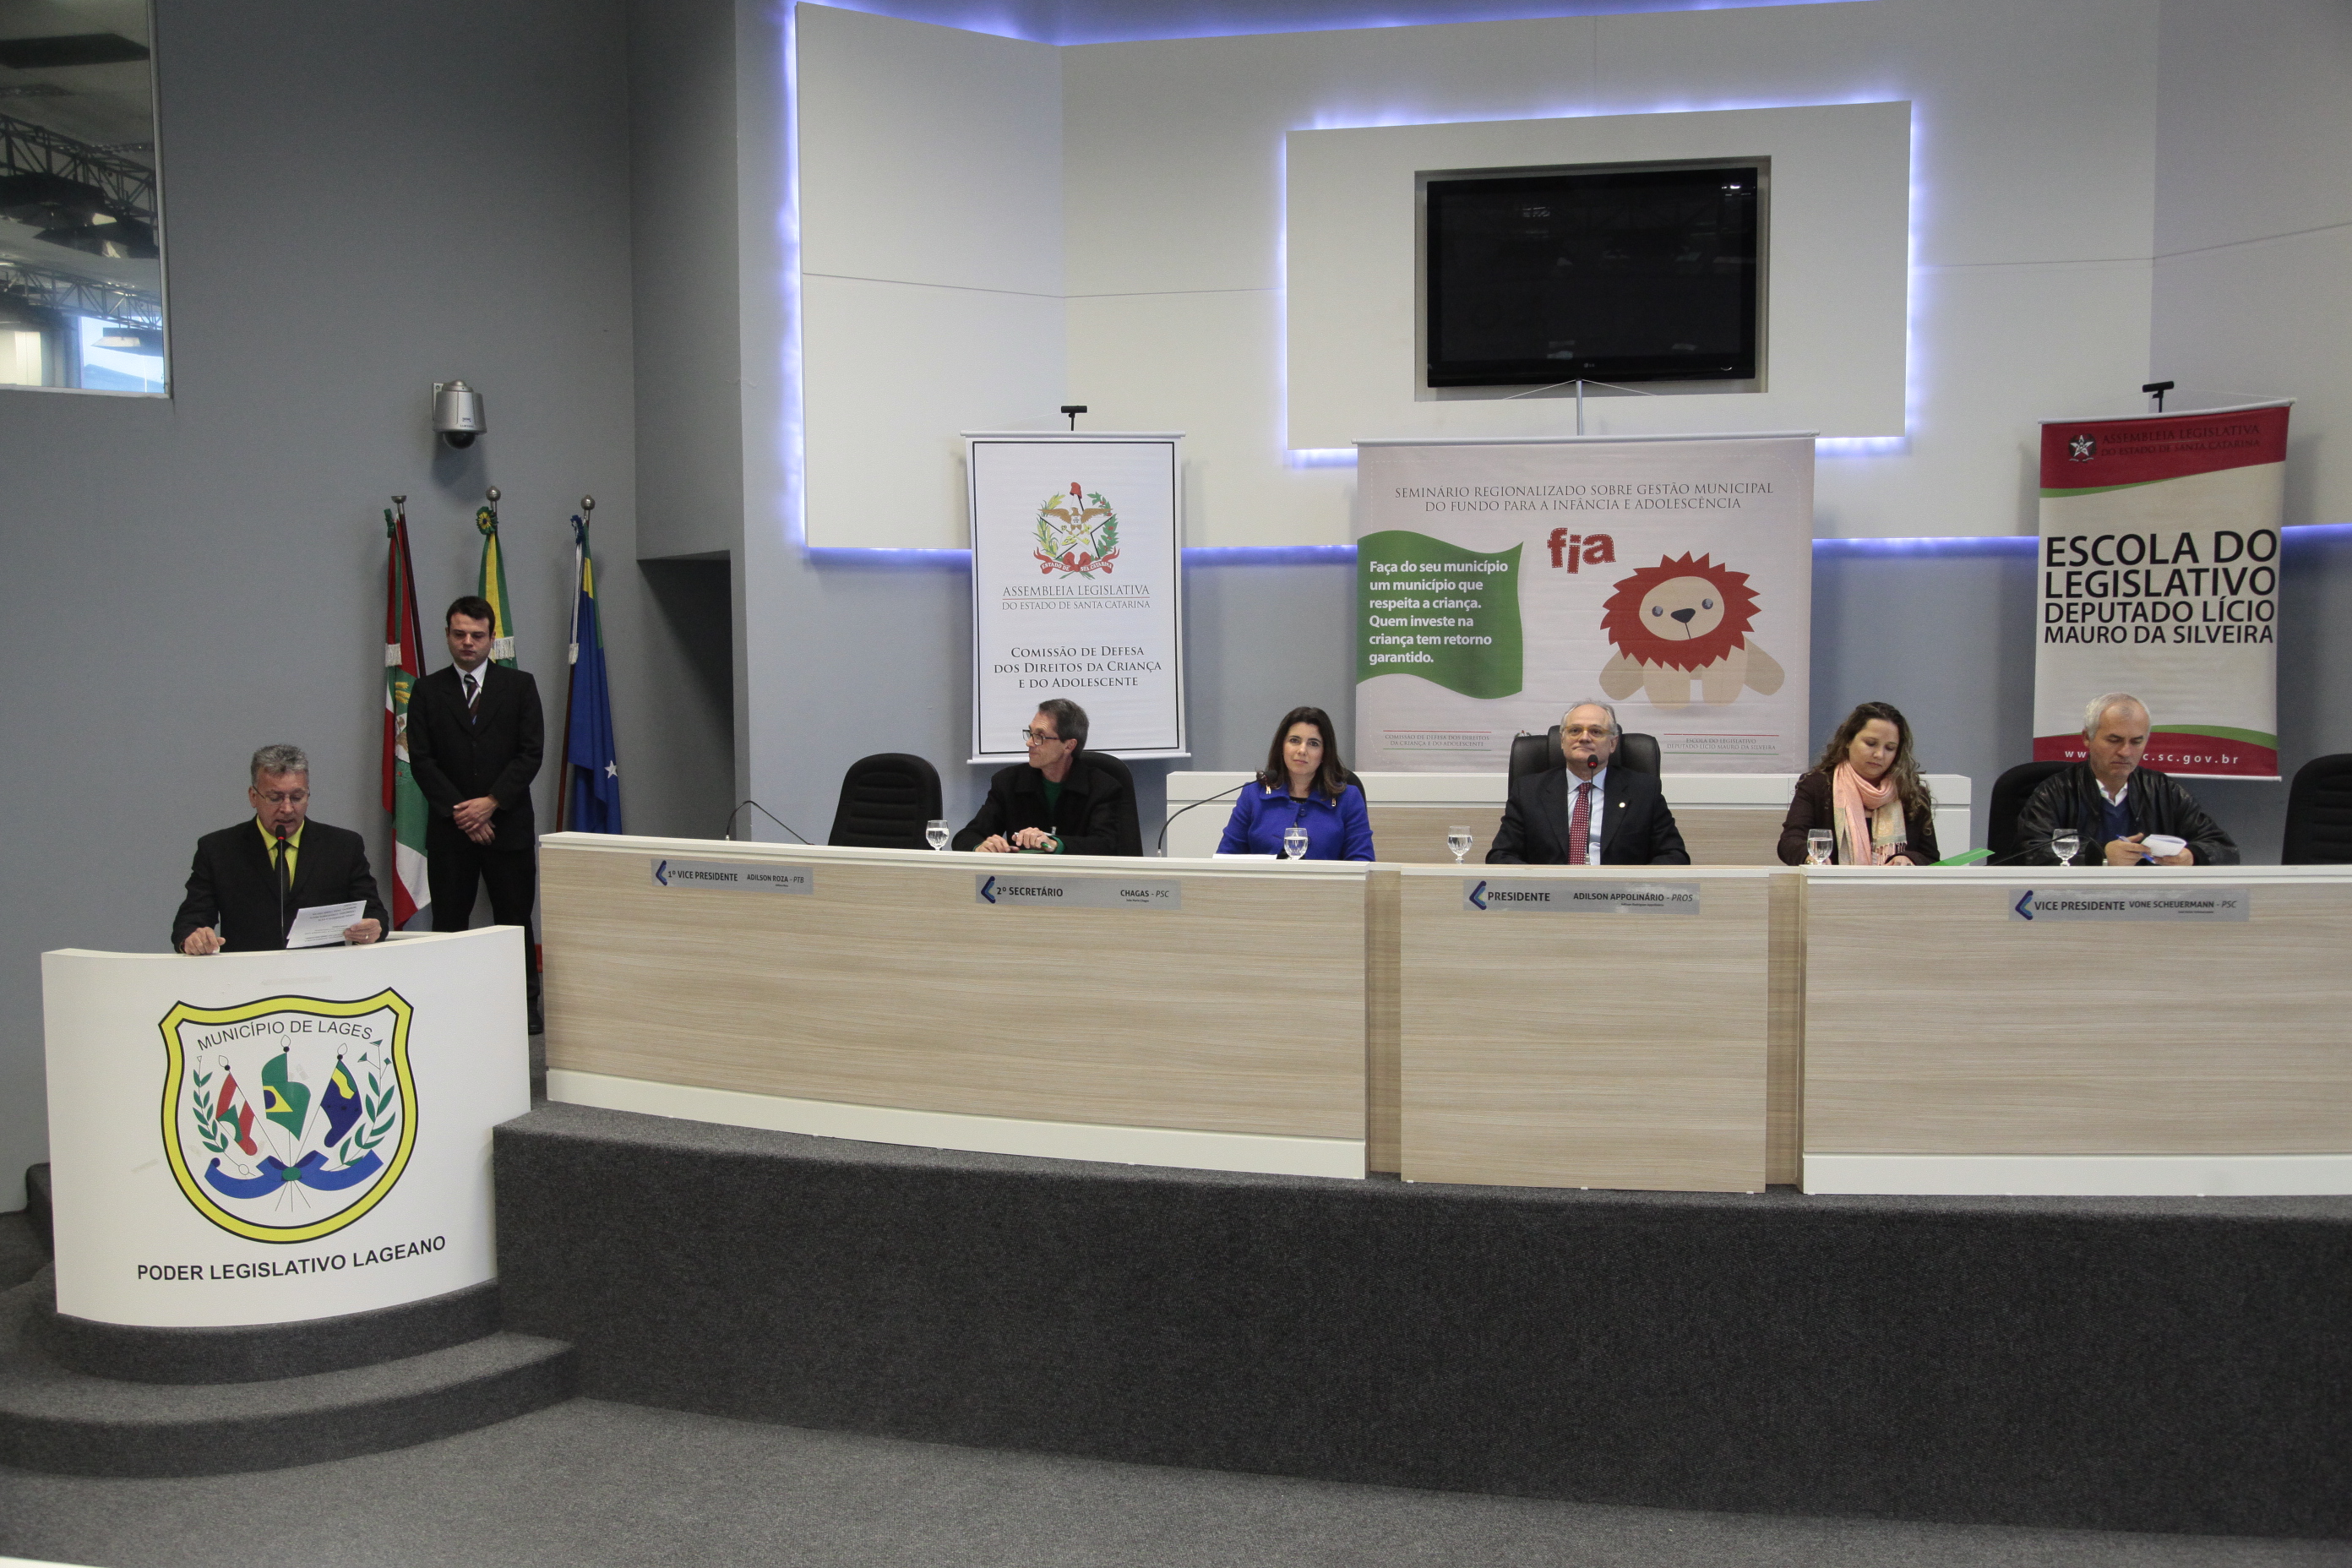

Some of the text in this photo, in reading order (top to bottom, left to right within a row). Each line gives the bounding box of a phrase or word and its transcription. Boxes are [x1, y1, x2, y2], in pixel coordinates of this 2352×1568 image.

[2103, 425, 2260, 444] ASSEMBLEIA LEGISLATIVA
[2119, 446, 2153, 455] ESTADO
[2174, 444, 2204, 452] SANTA
[2208, 439, 2260, 449] CATARINA
[1395, 482, 1774, 498] SEMINÁRIO REGIONALIZADO SOBRE GESTÃO MUNICIPAL
[1425, 497, 1741, 512] DO FUNDO PARA A INFÂNCIA E ADOLESCÊNCIA
[2045, 529, 2278, 568] ESCOLA DO
[1369, 560, 1508, 575] Faça do seu município
[1370, 579, 1483, 592] um município que
[2045, 566, 2276, 599] LEGISLATIVO
[1003, 585, 1150, 596] ASSEMBLEIA LEGISLATIVA
[1002, 602, 1017, 610] DO
[1021, 602, 1056, 610] ESTADO
[1074, 601, 1102, 609] SANTA
[1369, 597, 1481, 611] respeita a criança.
[2044, 596, 2274, 623] DEPUTADO LÍCIO
[1369, 615, 1407, 628] Quem
[1411, 615, 1455, 626] investe
[1369, 634, 1492, 647] criança tem retorno
[2044, 625, 2273, 645] MAURO DA SILVEIRA
[1011, 646, 1144, 657] COMISSÃO DE DEFESA
[1369, 651, 1434, 665] garantido.
[994, 662, 1162, 673] DOS DIREITOS DA CRIANÇA
[1030, 679, 1048, 688] DO
[1052, 678, 1138, 688] ADOLESCENTE
[694, 872, 738, 881] PRESIDENTE
[1010, 886, 1063, 896] SECRETÁRIO
[1487, 892, 1551, 902] PRESIDENTE
[1573, 892, 1609, 901] ADILSON
[1610, 892, 1664, 901] APPOLINÁRIO
[1671, 894, 1693, 902] PROS
[2034, 901, 2126, 911] VICE PRESIDENTE
[197, 1021, 373, 1051] MUNICÍPIO DE LAGES
[138, 1236, 446, 1281] PODER LEGISLATIVO LAGEANO
